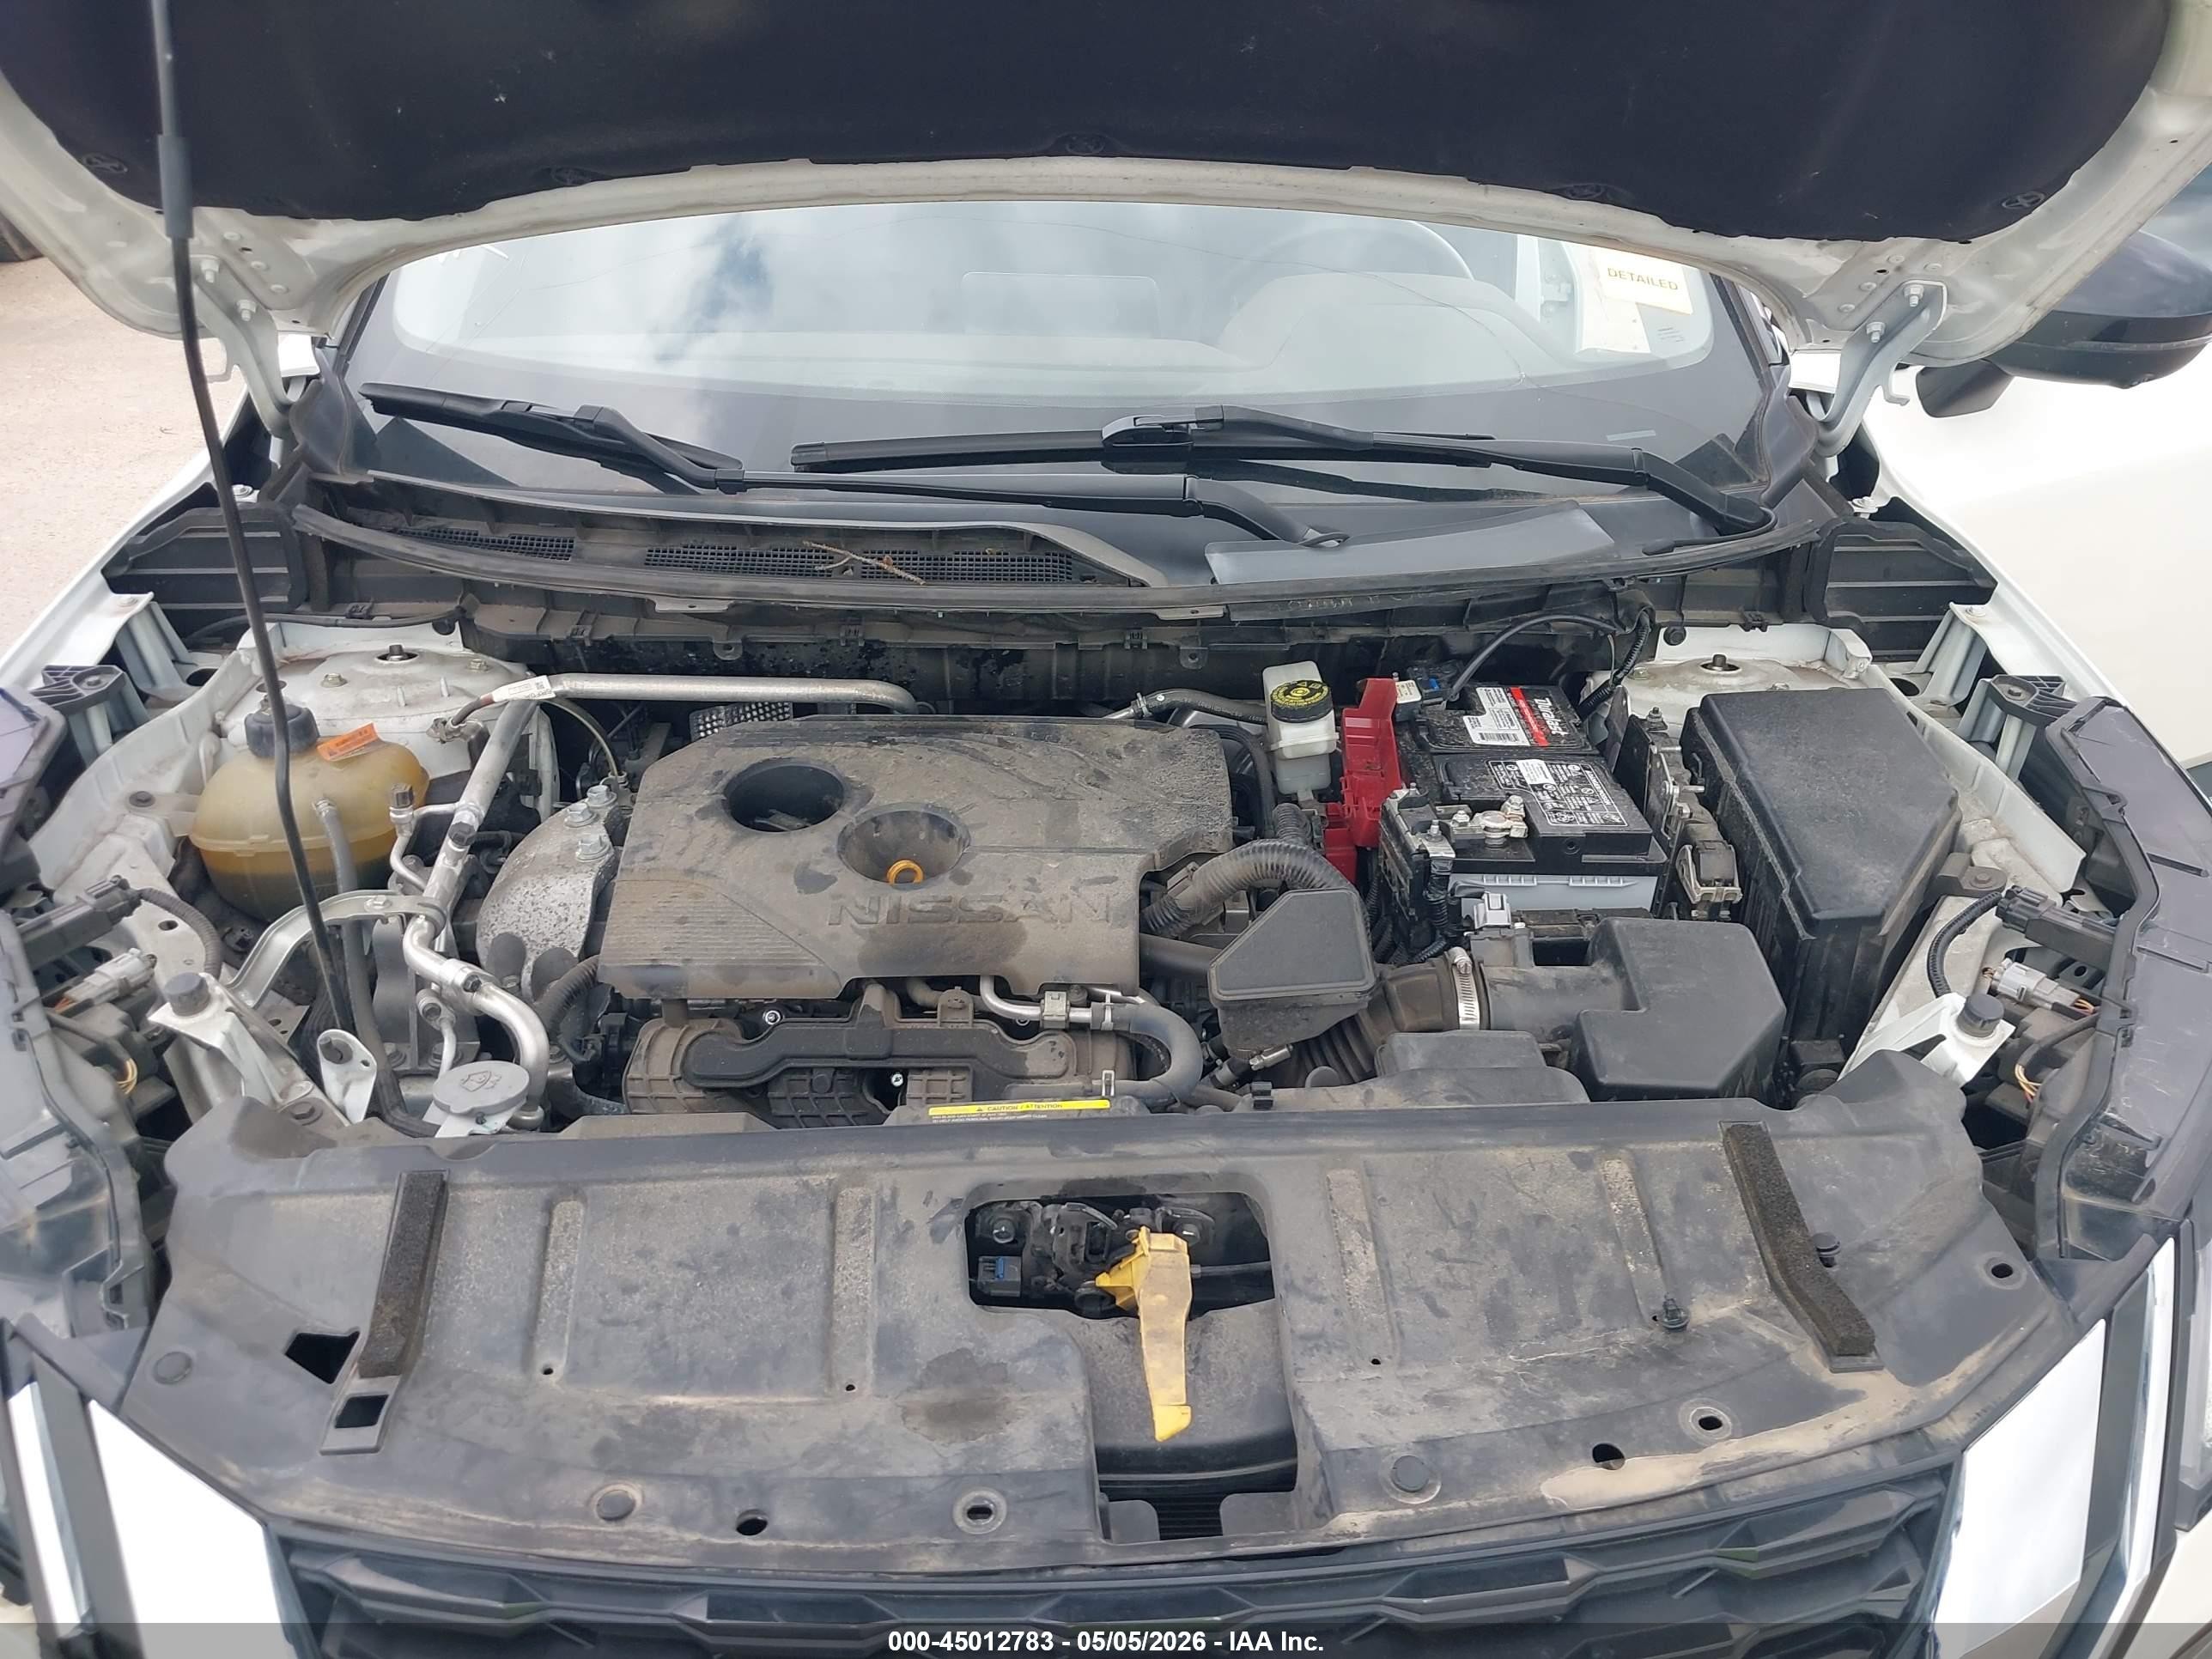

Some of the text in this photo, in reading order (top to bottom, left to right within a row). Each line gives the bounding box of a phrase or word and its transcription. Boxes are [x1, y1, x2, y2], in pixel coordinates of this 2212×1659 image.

[1607, 267, 1679, 290] DETAILED
[1534, 697, 1570, 736] Duralast
[827, 893, 1111, 926] NISSAN
